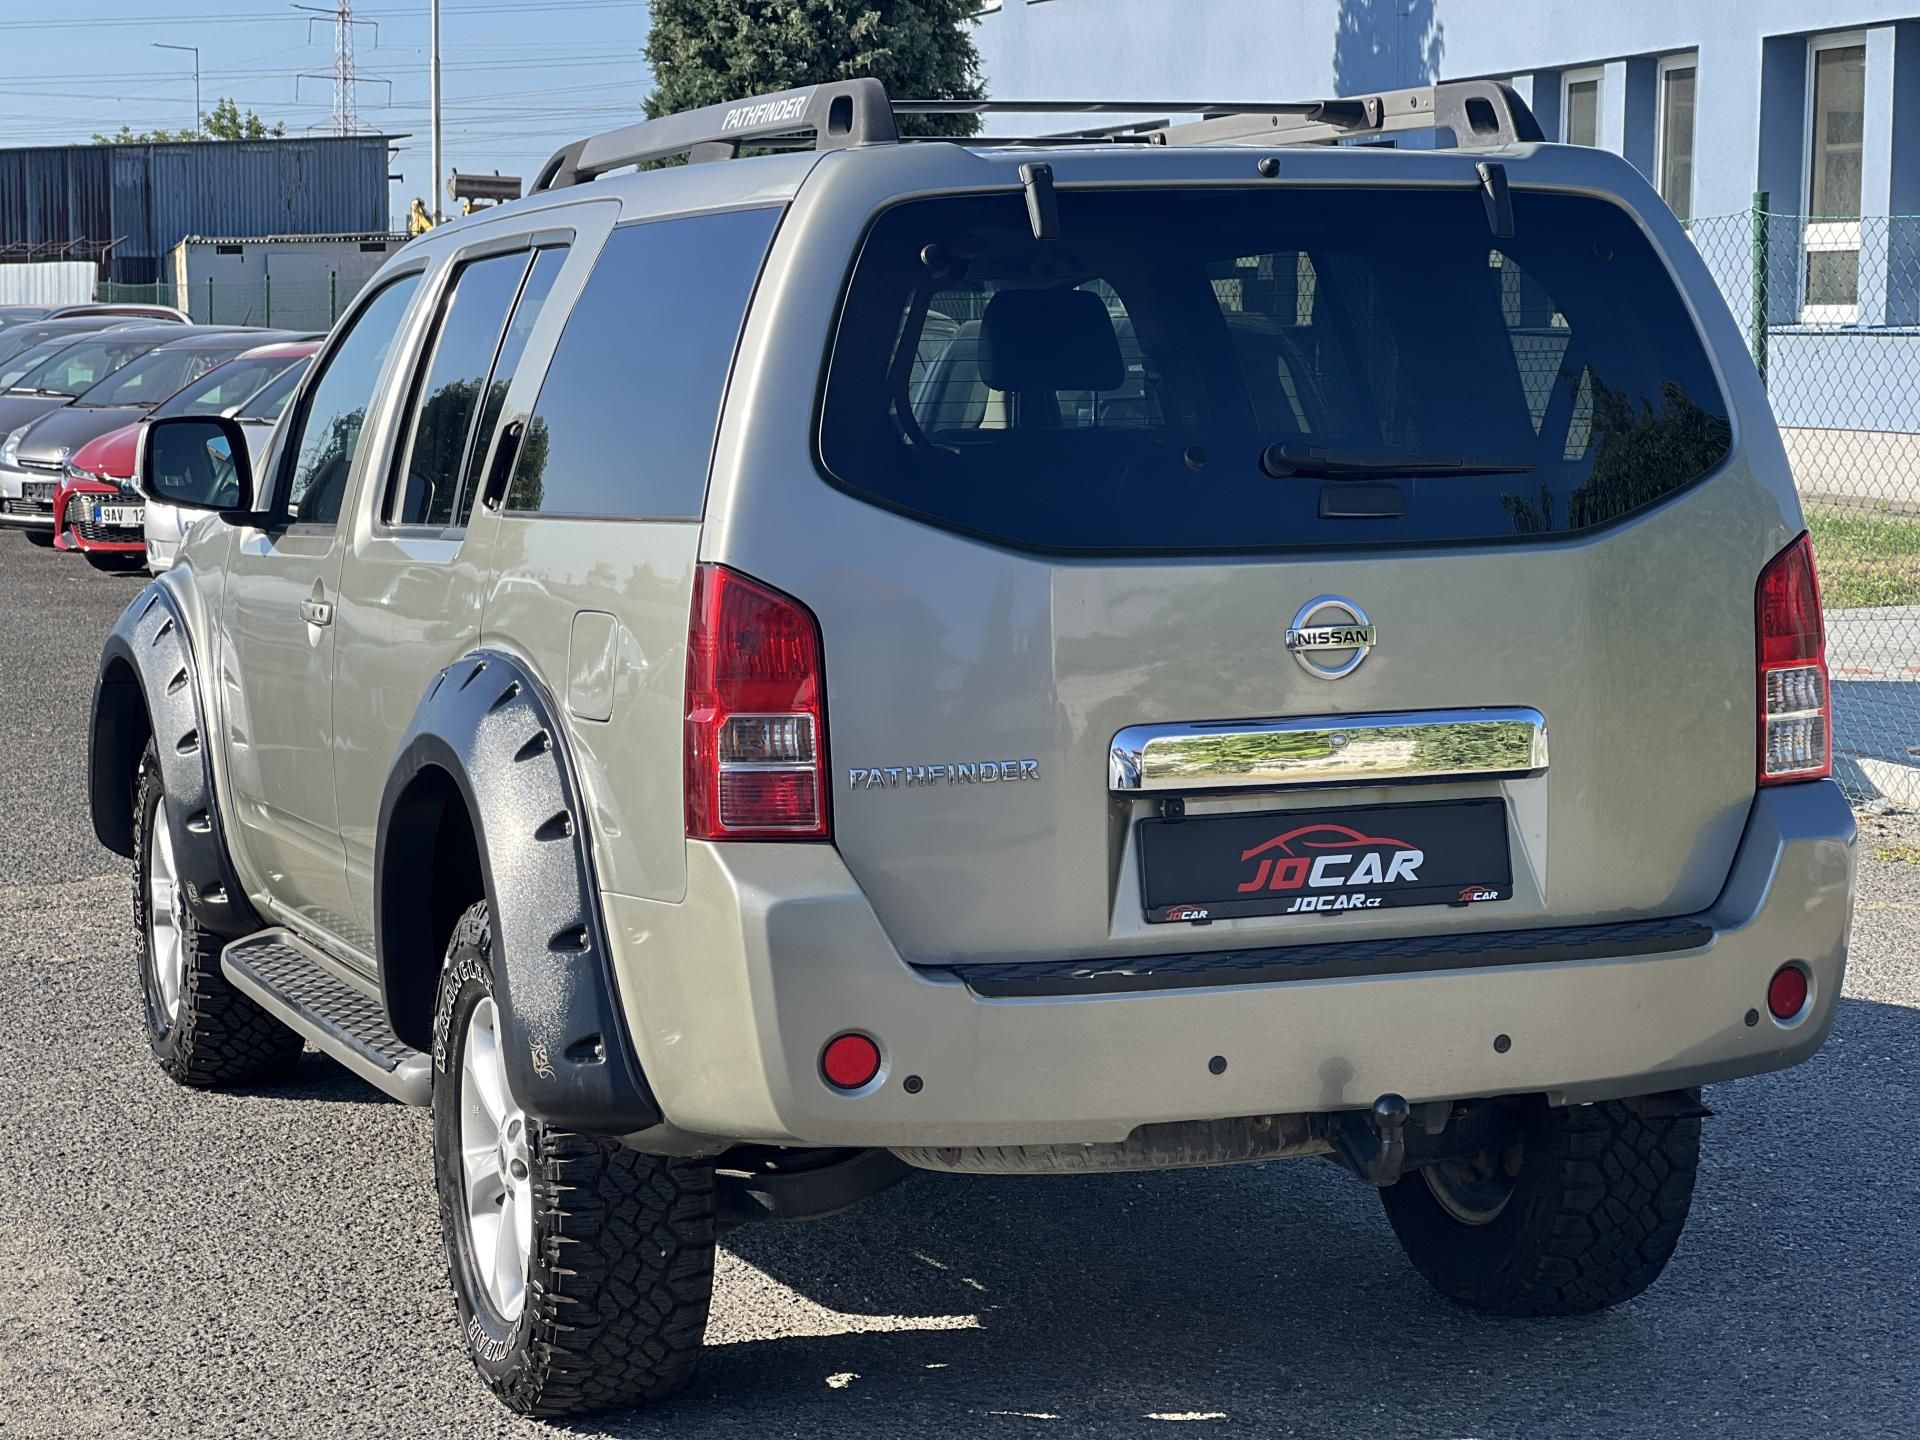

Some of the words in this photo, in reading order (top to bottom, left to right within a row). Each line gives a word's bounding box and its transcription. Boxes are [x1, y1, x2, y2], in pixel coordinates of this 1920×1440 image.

[722, 96, 806, 130] PATHFINDER
[104, 508, 123, 521] 9AV
[1298, 630, 1368, 645] NISSAN
[849, 759, 1040, 790] PATHFINDER
[1238, 850, 1424, 892] JOCAR
[1459, 891, 1498, 901] JOCAR
[1166, 910, 1208, 920] JOCAR
